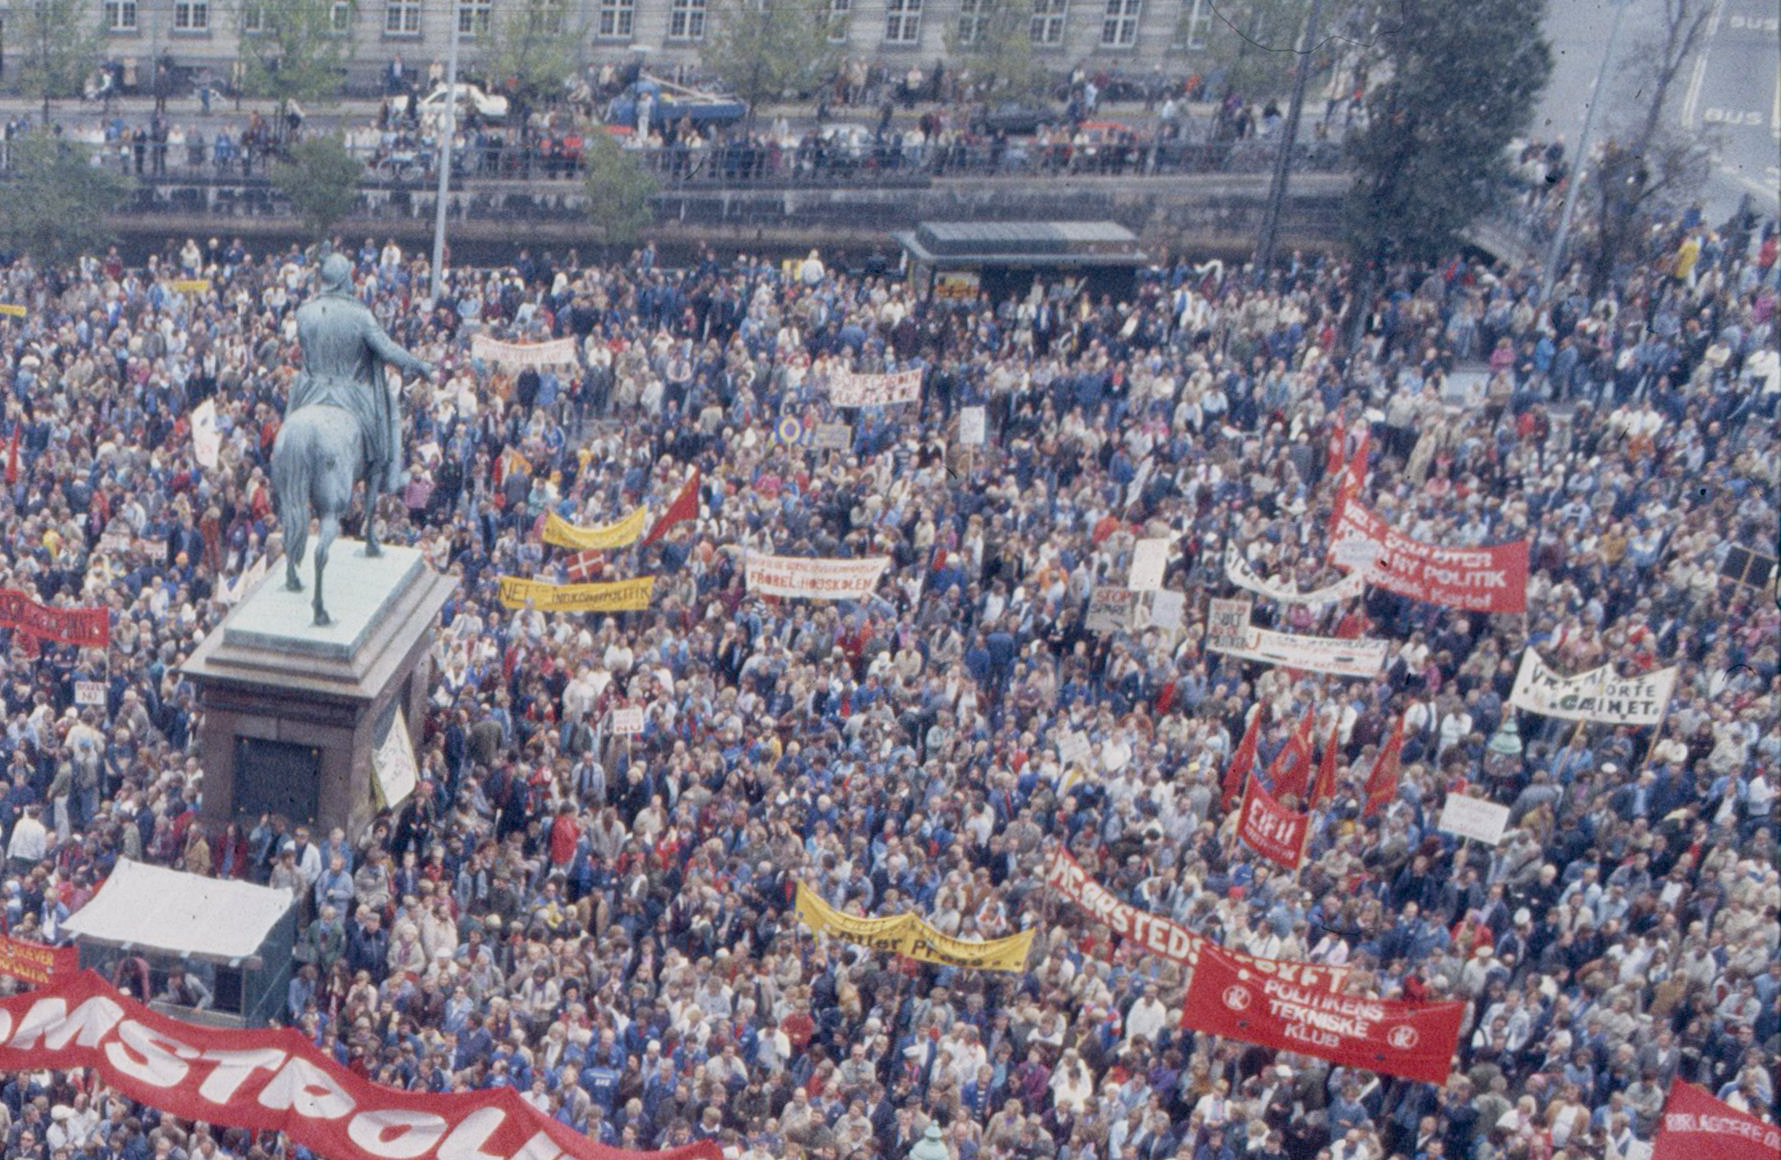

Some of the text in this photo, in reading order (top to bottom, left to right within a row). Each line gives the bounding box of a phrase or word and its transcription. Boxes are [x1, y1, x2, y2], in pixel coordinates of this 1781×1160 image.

[1730, 15, 1779, 31] BUS
[1705, 107, 1763, 125] BUS
[1423, 565, 1507, 588] POLITIK
[1263, 979, 1385, 1022] POLITIKENS
[1268, 999, 1370, 1039] TEKNISKE
[1284, 1022, 1341, 1048] KLUB
